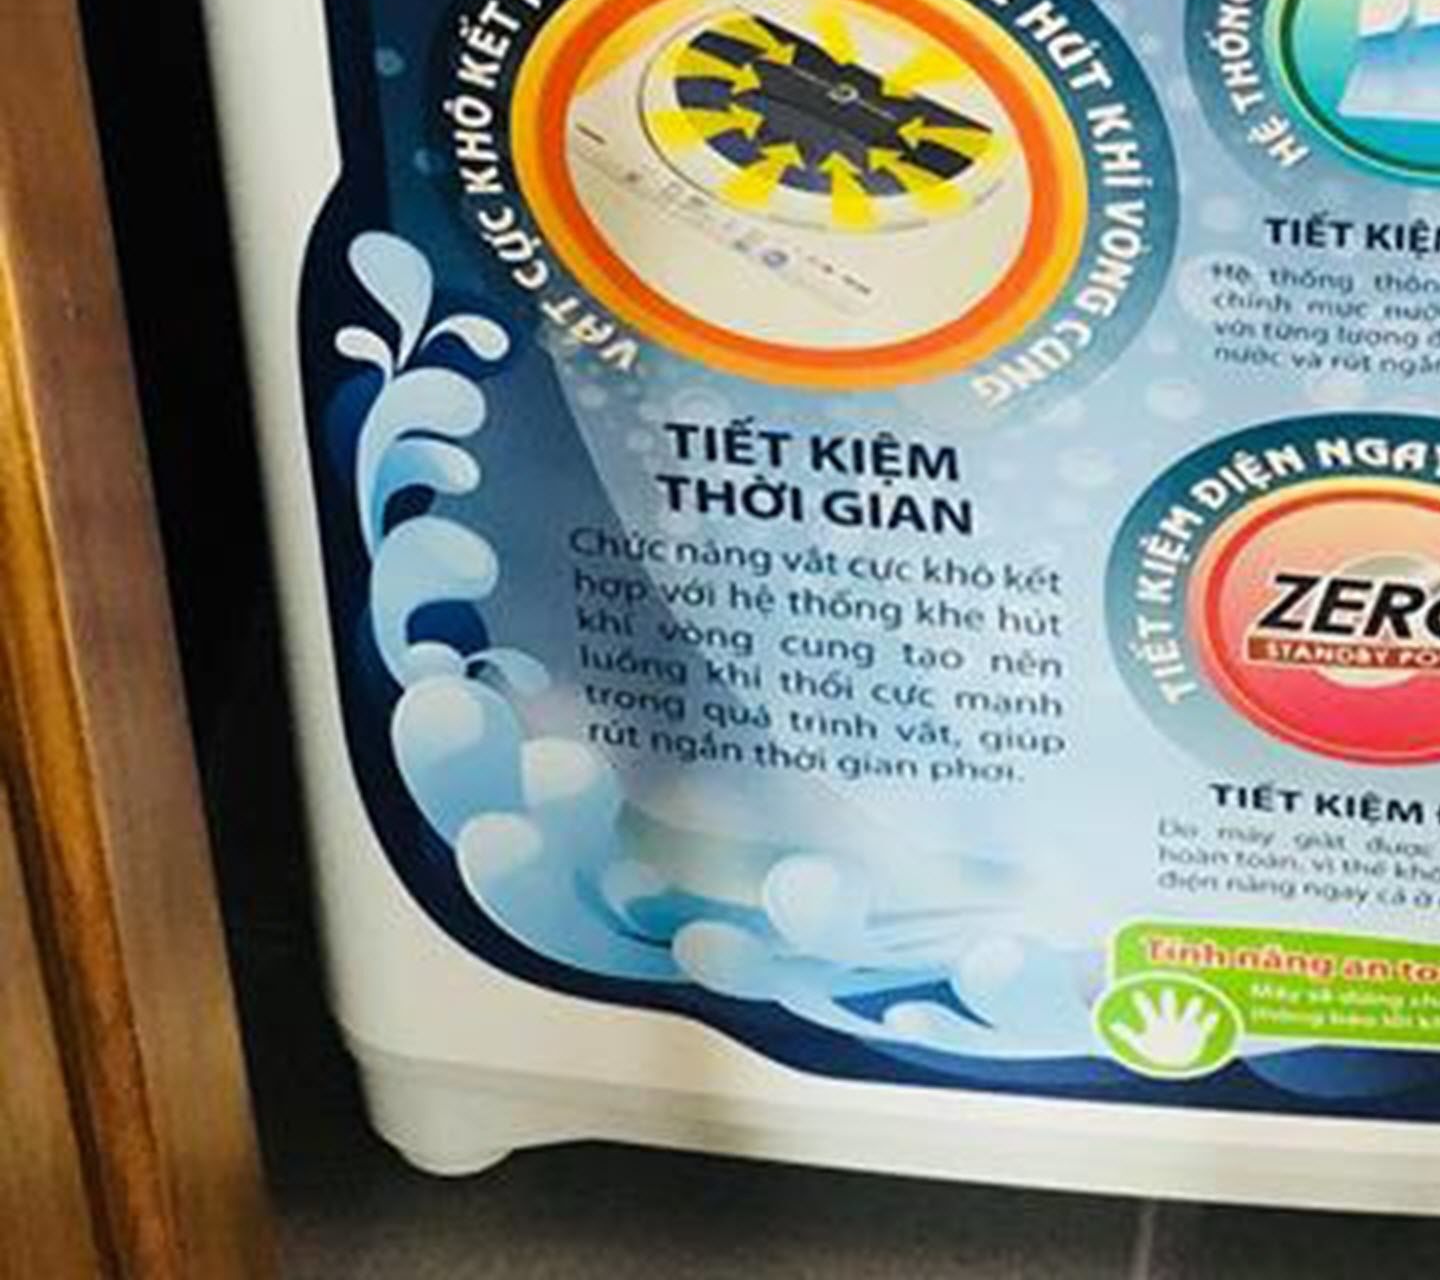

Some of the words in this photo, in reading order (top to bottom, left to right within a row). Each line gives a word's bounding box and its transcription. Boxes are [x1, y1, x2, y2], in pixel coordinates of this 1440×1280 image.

[442, 93, 505, 194] KHÔ
[1087, 102, 1153, 188] KHÍ
[1263, 209, 1354, 248] TIẾT
[970, 318, 1092, 408] CUNG
[662, 415, 793, 468] TIẾT
[810, 430, 960, 487] KIỆM
[1189, 442, 1306, 511] ĐIỆN
[654, 472, 804, 523] THỜI
[820, 489, 974, 536] GIAN
[568, 525, 668, 563] Chức
[915, 596, 986, 630] khe
[779, 634, 876, 670] cung
[1265, 641, 1391, 665] STANDBY
[585, 683, 687, 724] trong
[836, 750, 920, 781] gian
[1208, 779, 1304, 814] TIẾT
[1314, 790, 1425, 828] KIỆM
